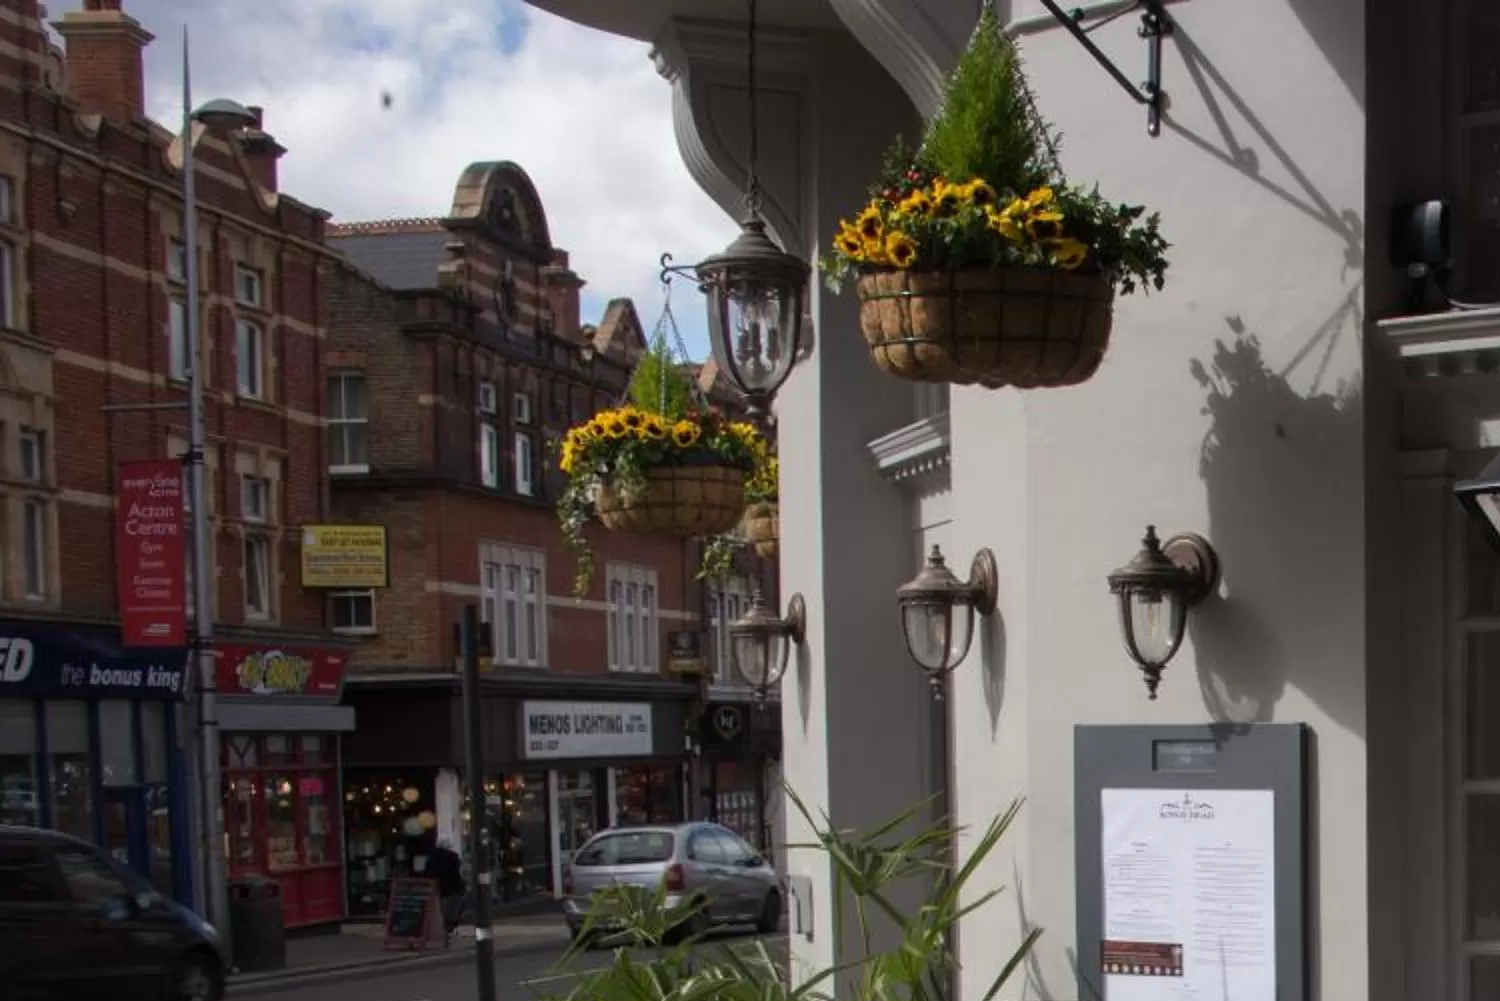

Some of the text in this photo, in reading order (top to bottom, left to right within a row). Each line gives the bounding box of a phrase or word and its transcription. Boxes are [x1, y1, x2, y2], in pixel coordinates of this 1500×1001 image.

[127, 502, 175, 518] Acton
[124, 519, 177, 536] Centre
[90, 663, 142, 686] bonus
[147, 664, 181, 692] king
[529, 714, 571, 735] MENOS
[574, 713, 623, 735] LIGHTING
